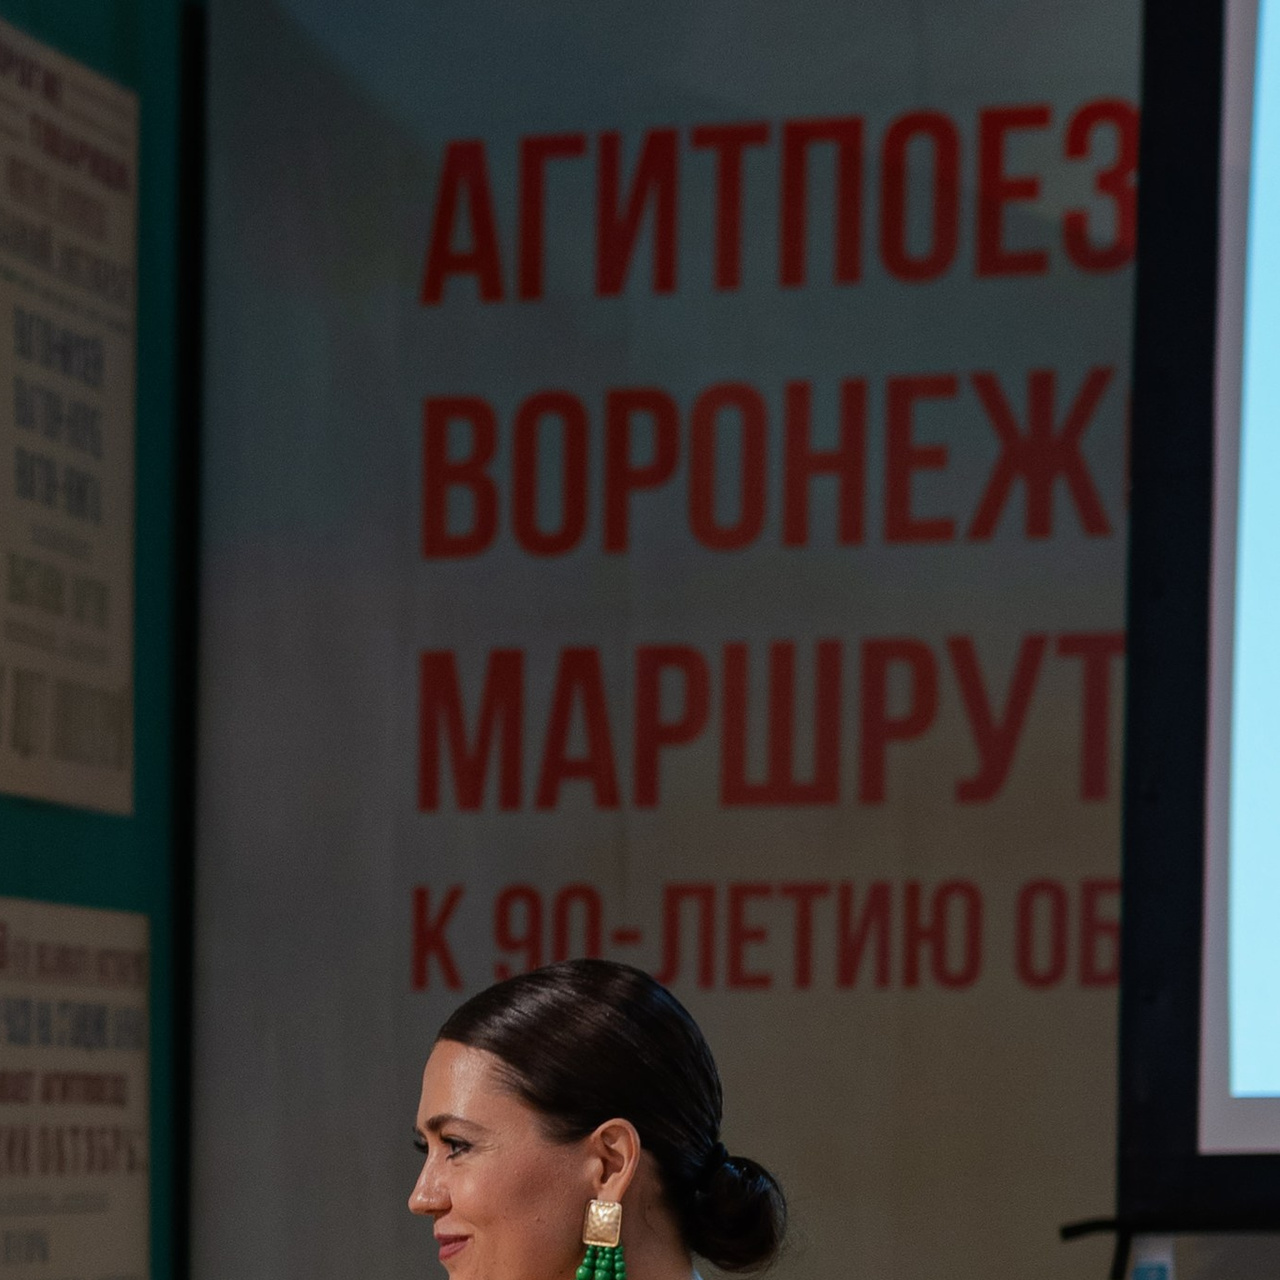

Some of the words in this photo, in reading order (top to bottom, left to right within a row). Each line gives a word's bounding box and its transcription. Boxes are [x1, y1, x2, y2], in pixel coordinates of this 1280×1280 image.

[417, 96, 1141, 307] АГИТПОЕЗ
[421, 363, 1131, 560] ВОРОНЕЖ
[416, 628, 1127, 815] МАРШРУТ
[410, 883, 464, 992] К
[493, 877, 985, 992] 90-ЛЕТИЮ
